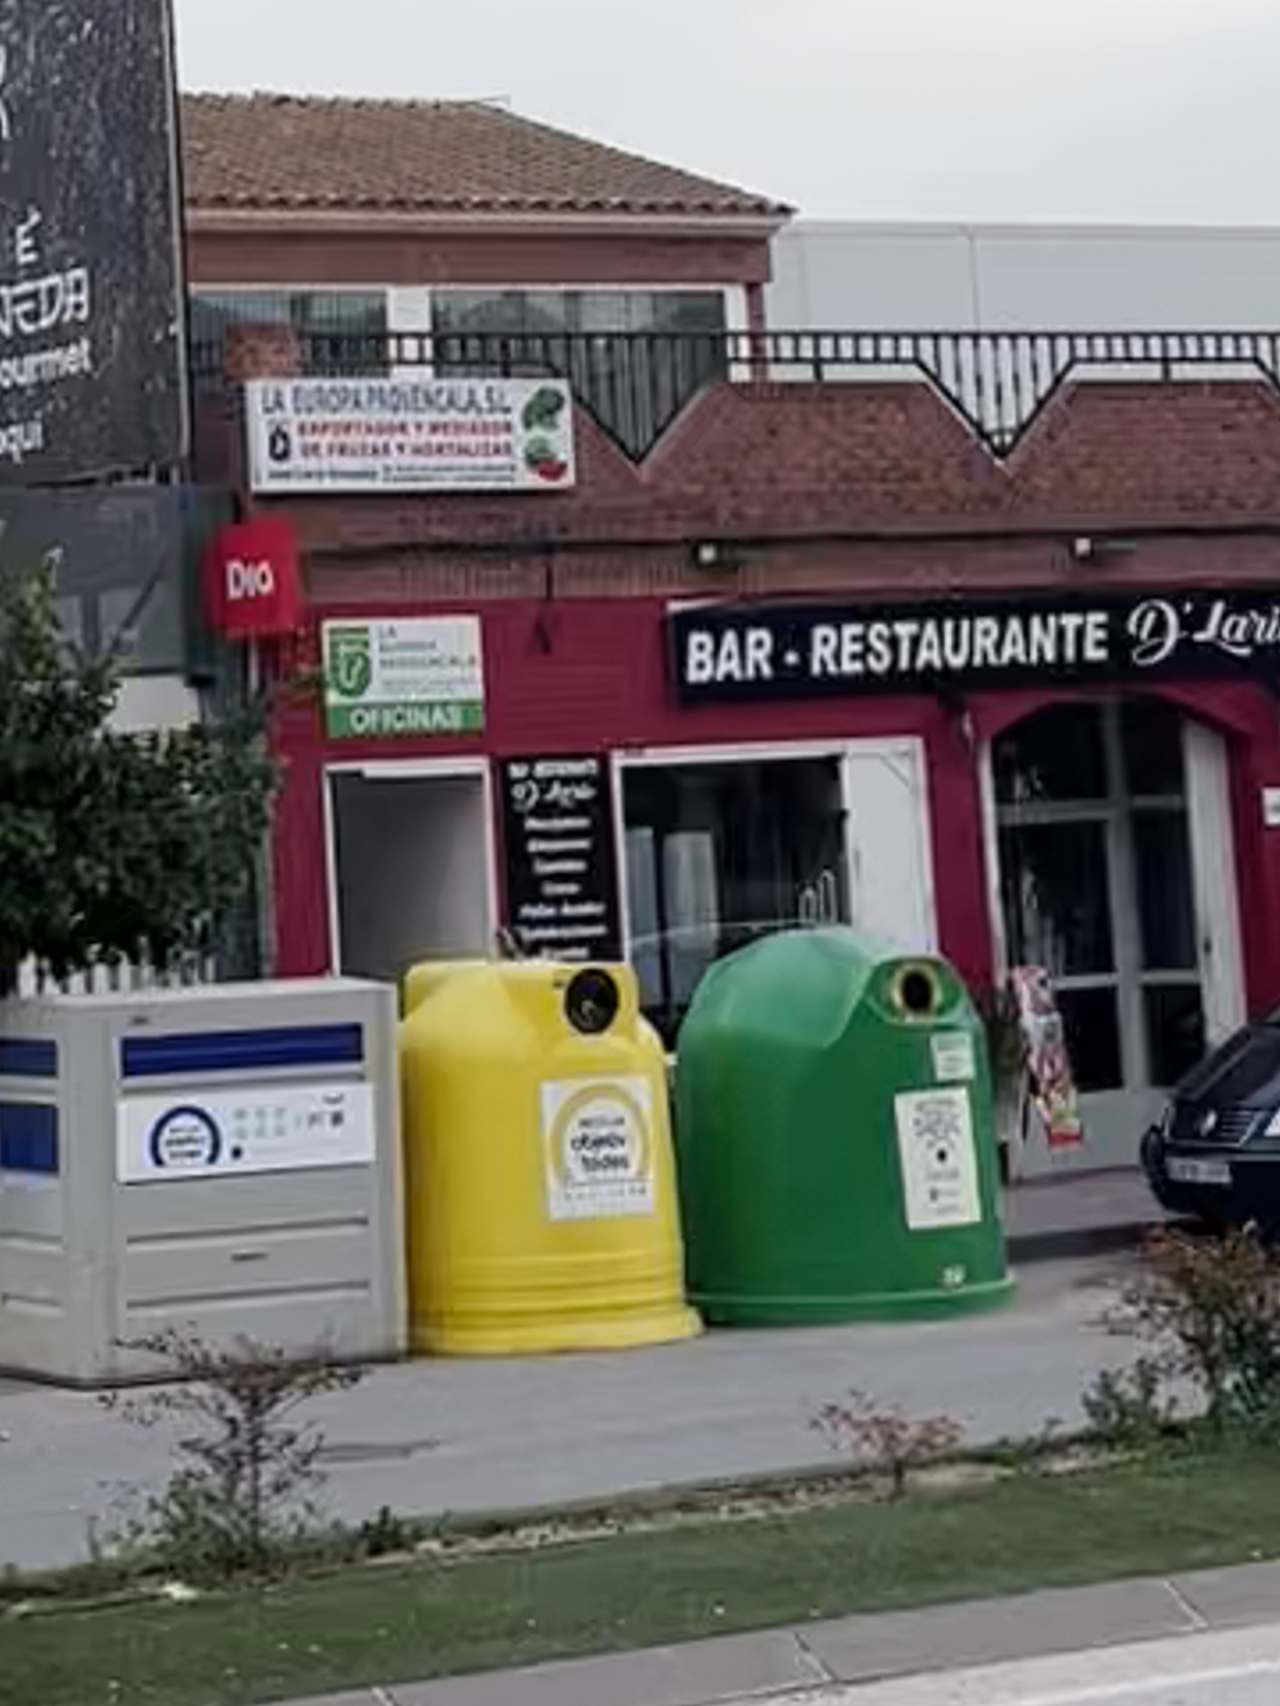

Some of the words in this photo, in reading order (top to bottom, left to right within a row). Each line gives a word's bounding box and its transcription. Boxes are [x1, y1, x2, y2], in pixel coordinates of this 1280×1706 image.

[686, 627, 773, 683] BAR
[811, 612, 1110, 676] RESTAURANTE
[350, 704, 463, 732] OFICINAS
